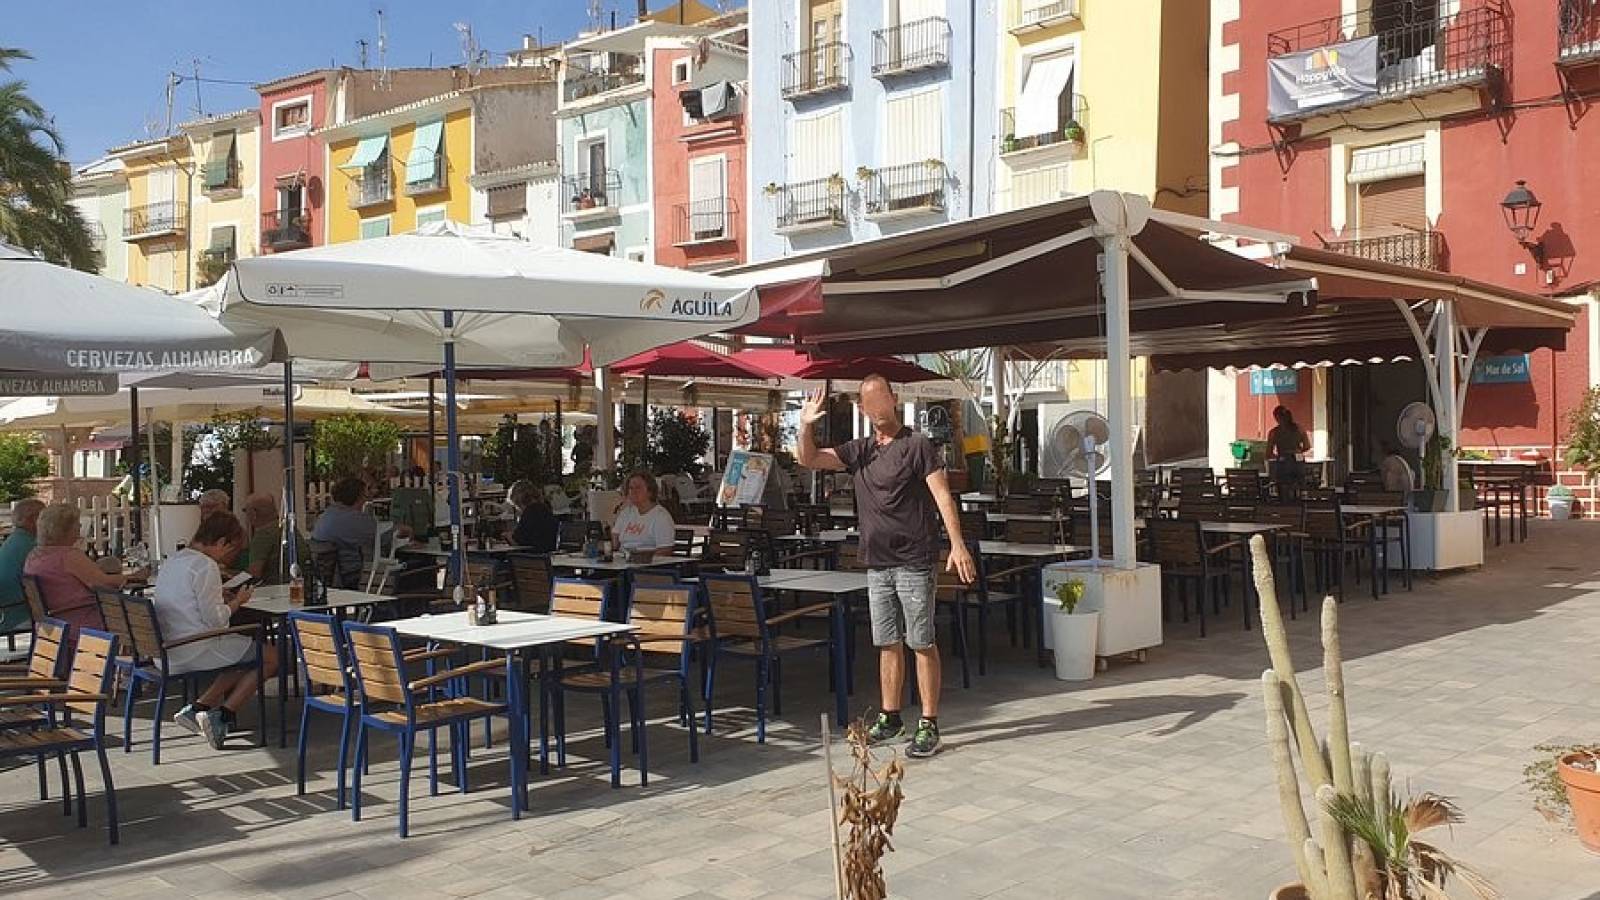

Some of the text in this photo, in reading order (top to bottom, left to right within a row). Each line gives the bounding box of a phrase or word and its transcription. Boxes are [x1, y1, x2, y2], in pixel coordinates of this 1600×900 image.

[67, 347, 255, 369] CERVEZAS ALHAMBRA
[41, 379, 104, 393] ALHAMBRA
